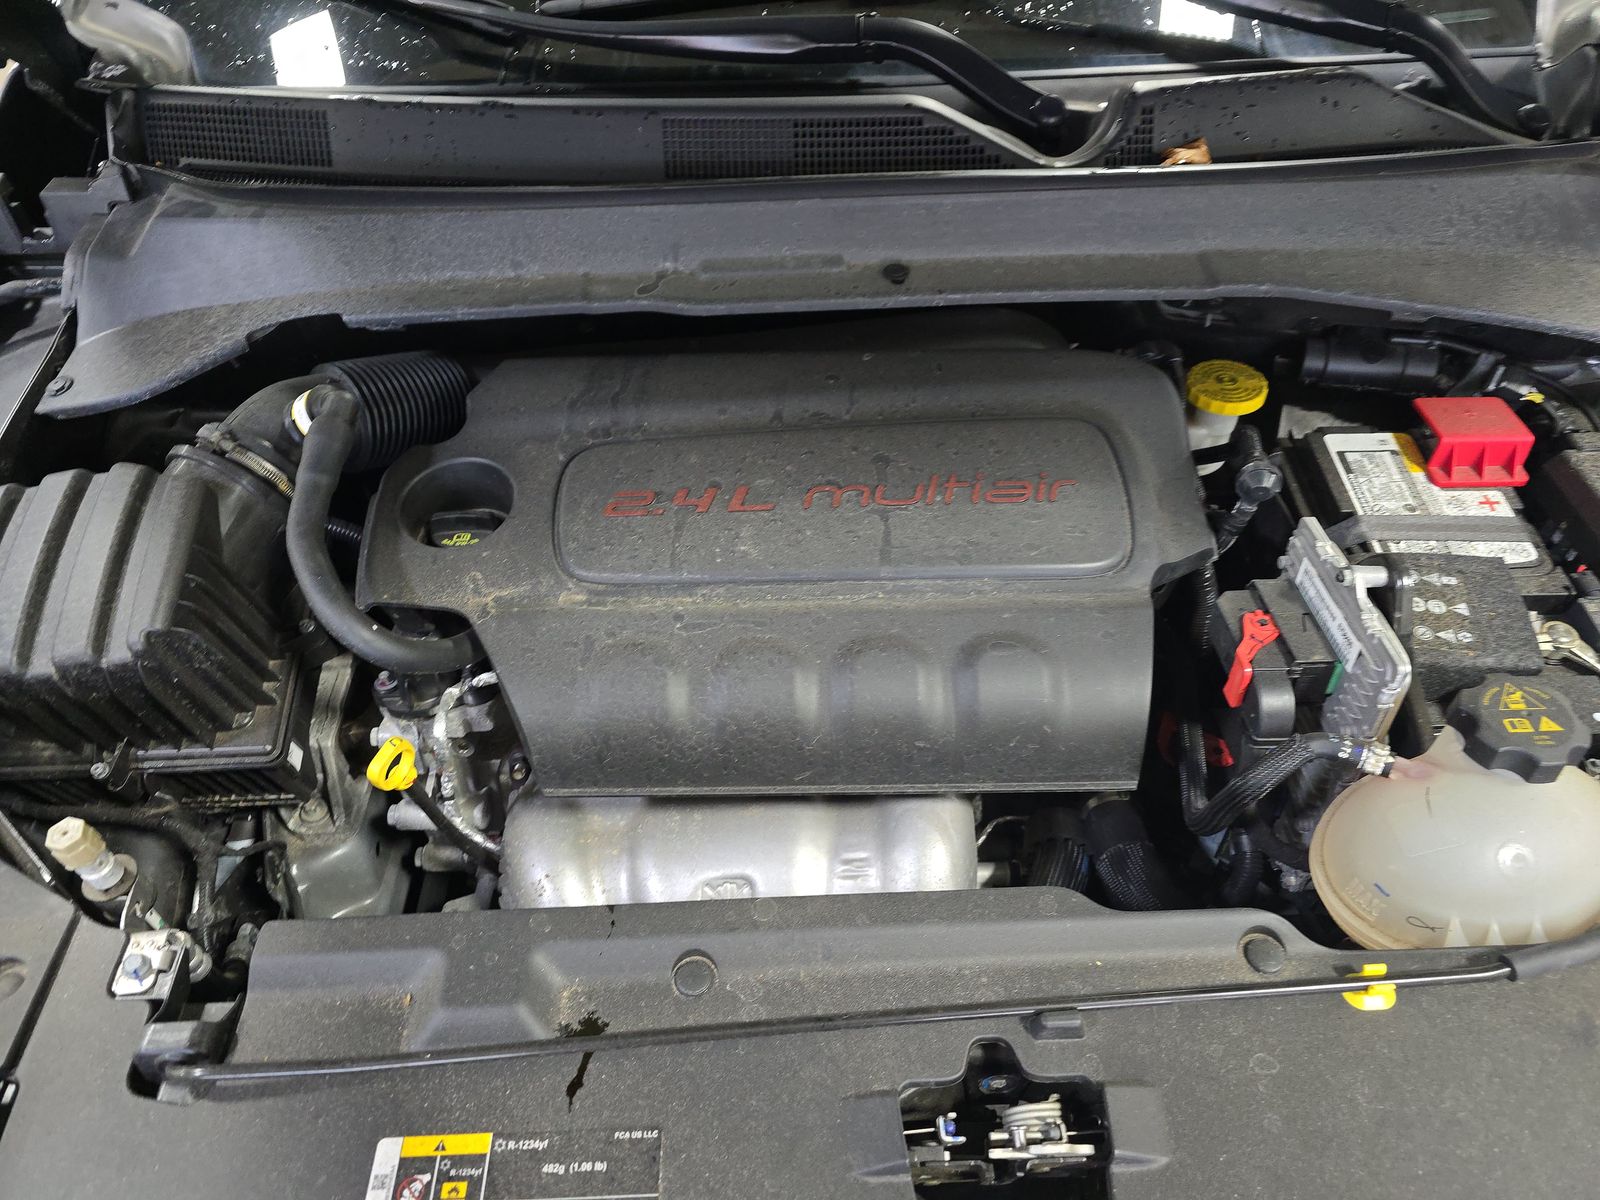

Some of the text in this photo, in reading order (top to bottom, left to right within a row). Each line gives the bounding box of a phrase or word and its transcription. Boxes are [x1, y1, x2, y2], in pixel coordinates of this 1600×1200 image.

[802, 471, 1079, 510] multiair
[614, 1130, 630, 1140] FCA
[643, 1129, 659, 1139] LLC
